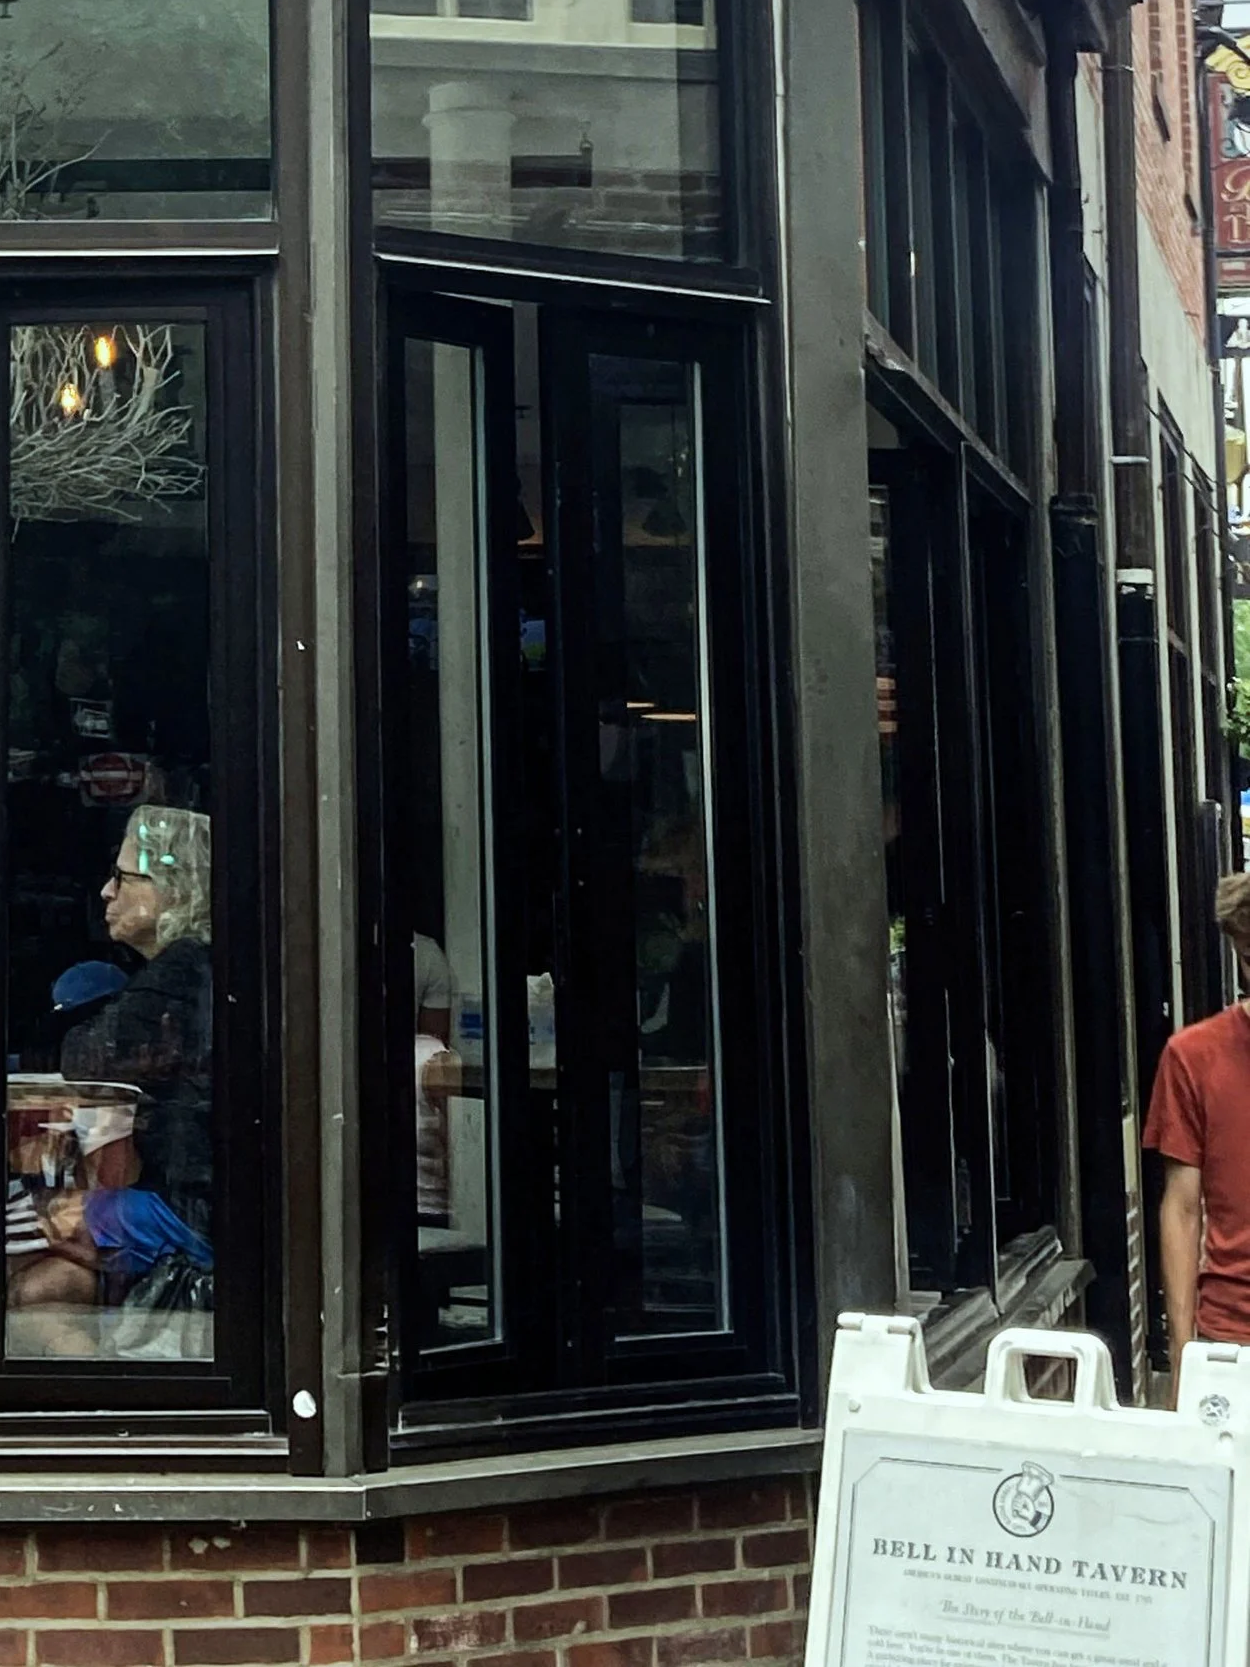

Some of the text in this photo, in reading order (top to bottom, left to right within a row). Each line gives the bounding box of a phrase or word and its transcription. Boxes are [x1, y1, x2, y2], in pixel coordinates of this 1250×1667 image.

[872, 1537, 938, 1562] BELL
[946, 1545, 976, 1566] IN
[985, 1550, 1063, 1576] HAND
[1071, 1559, 1189, 1590] TAVERN
